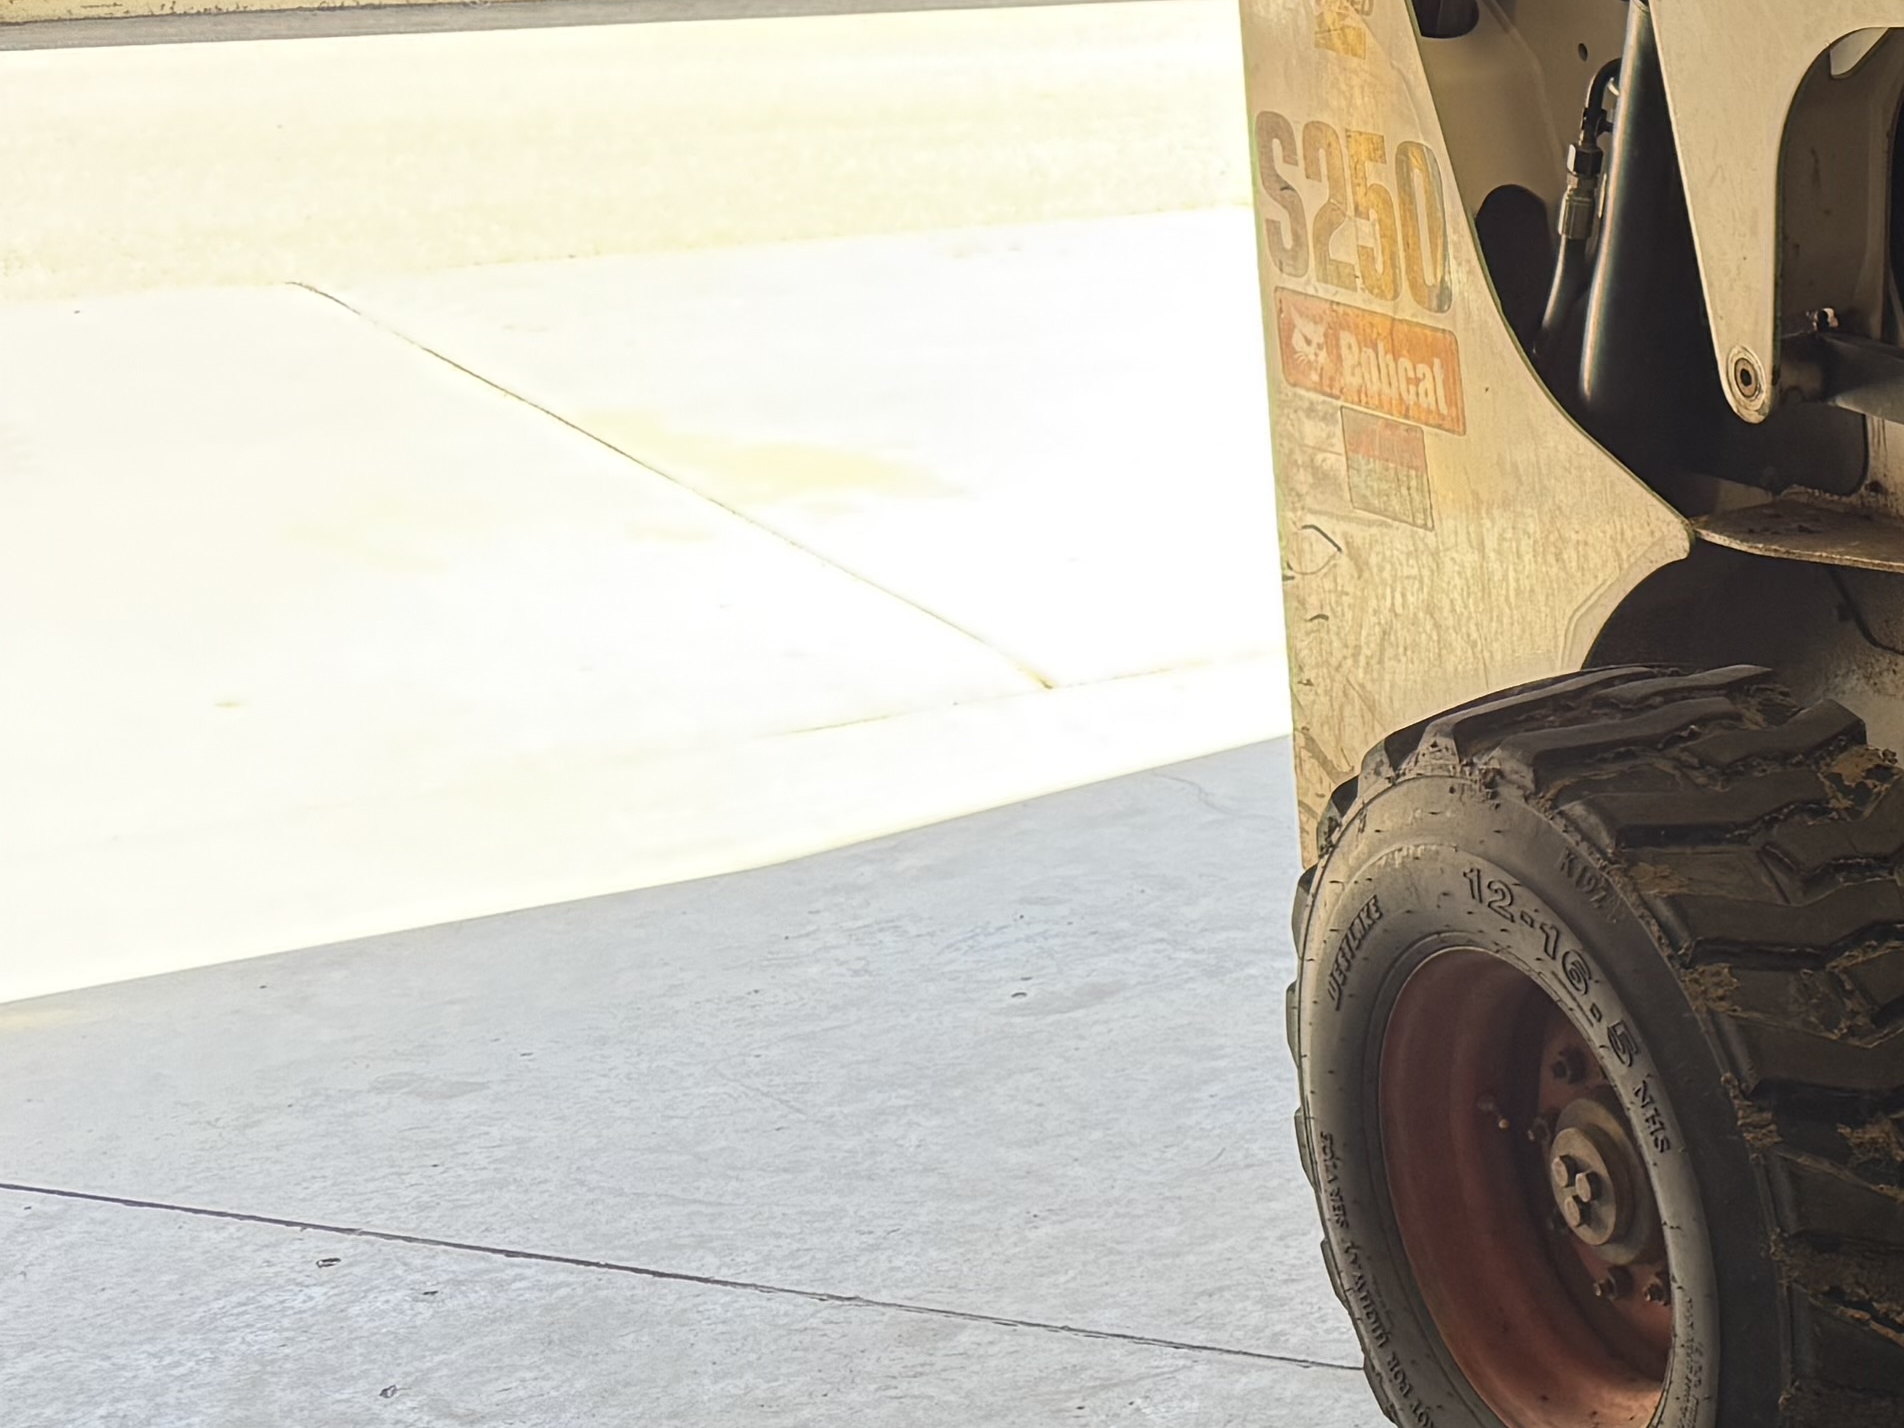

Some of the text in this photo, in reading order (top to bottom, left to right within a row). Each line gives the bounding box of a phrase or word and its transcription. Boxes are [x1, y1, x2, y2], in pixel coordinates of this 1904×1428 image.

[1255, 110, 1453, 314] S250
[1338, 330, 1449, 416] Bobcat
[1462, 867, 1672, 1155] 12-16.5 NHS
